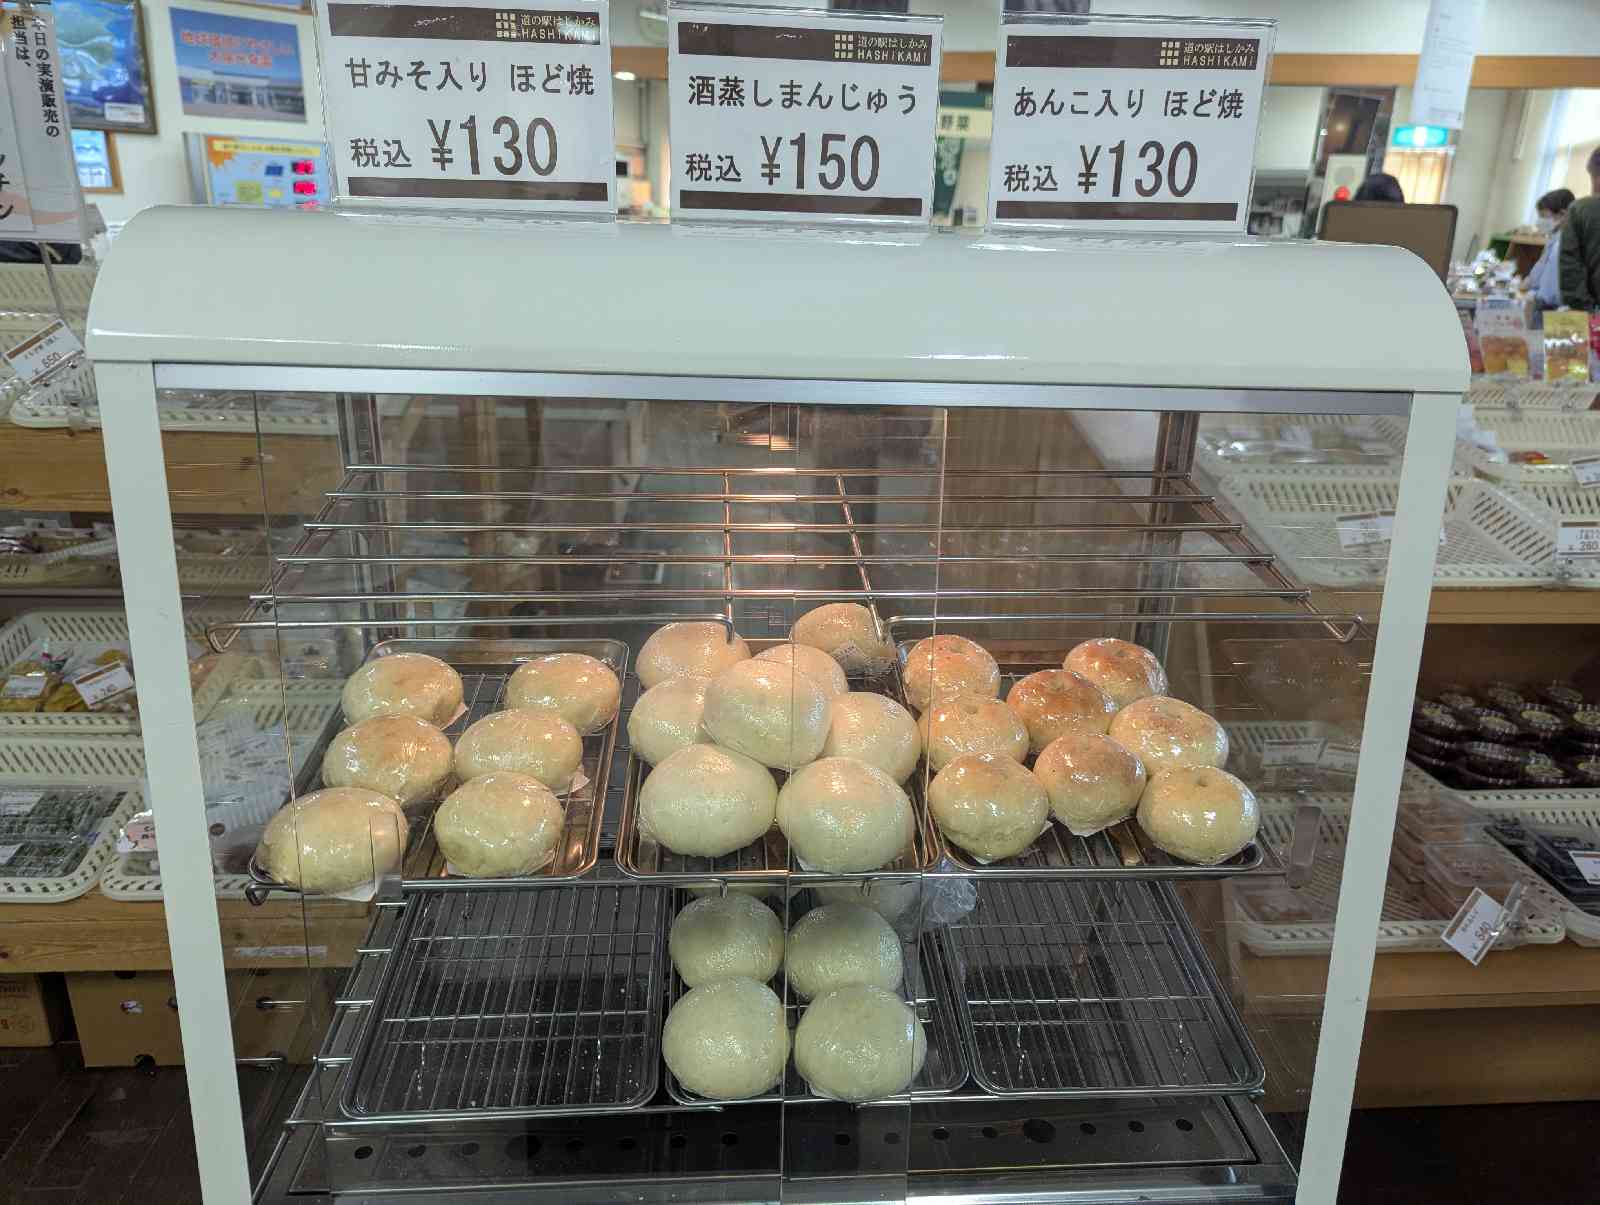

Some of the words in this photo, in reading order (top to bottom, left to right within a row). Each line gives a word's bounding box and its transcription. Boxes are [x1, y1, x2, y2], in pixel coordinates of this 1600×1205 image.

[857, 48, 927, 64] HASHIKAMI
[1183, 40, 1256, 54] 道の駅はしかみ
[1183, 55, 1255, 67] HASHIKAMI
[345, 57, 488, 93] 甘みそ入り
[510, 63, 596, 96] ほど焼
[687, 75, 917, 115] 酒蒸しまんじゅう
[1013, 86, 1145, 119] あんこ入り
[1163, 88, 1245, 119] ほど焼
[349, 137, 412, 168] 税込
[427, 114, 558, 176] ¥130
[684, 153, 742, 182] 税込
[760, 132, 880, 192] ¥150
[1003, 163, 1059, 193] 税込
[1077, 139, 1199, 198] ¥130
